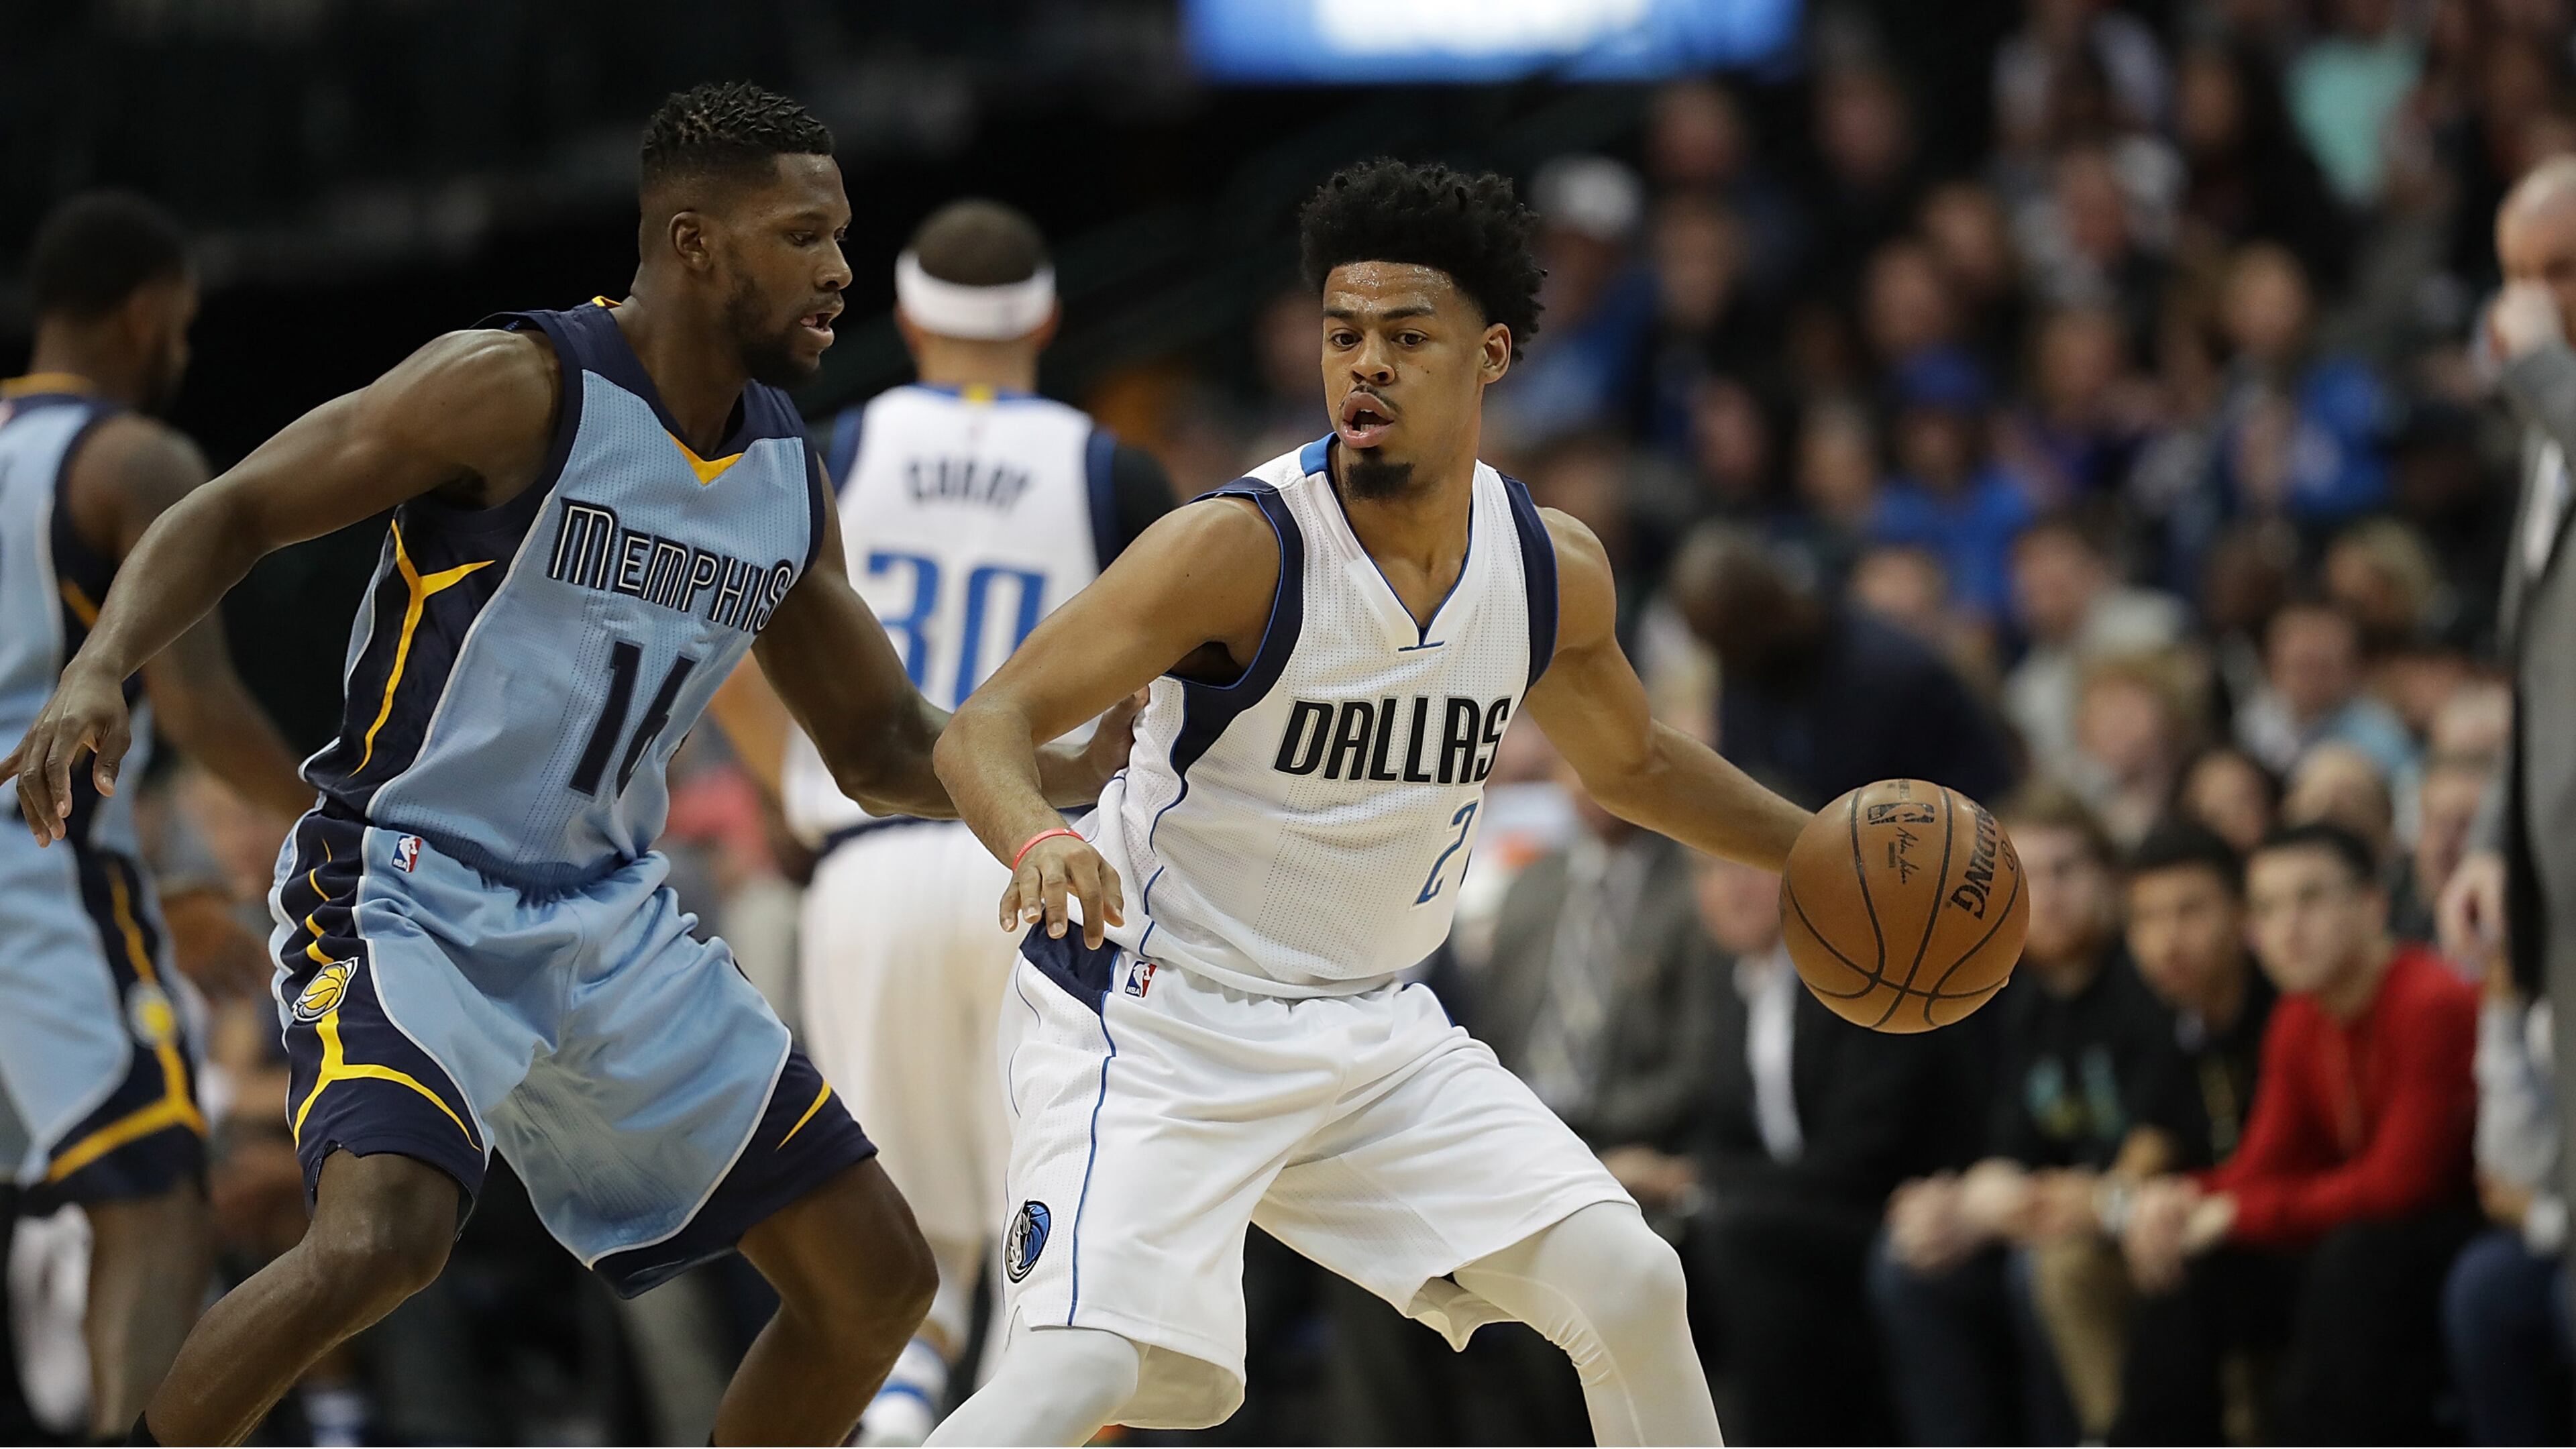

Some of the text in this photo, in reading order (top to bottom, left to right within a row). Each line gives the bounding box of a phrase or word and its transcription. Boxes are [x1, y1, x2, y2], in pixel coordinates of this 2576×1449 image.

[547, 496, 793, 635] MEMPHIS
[867, 551, 1046, 710] 30
[1272, 696, 1512, 786] DALLAS
[1126, 986, 1140, 995] NBA
